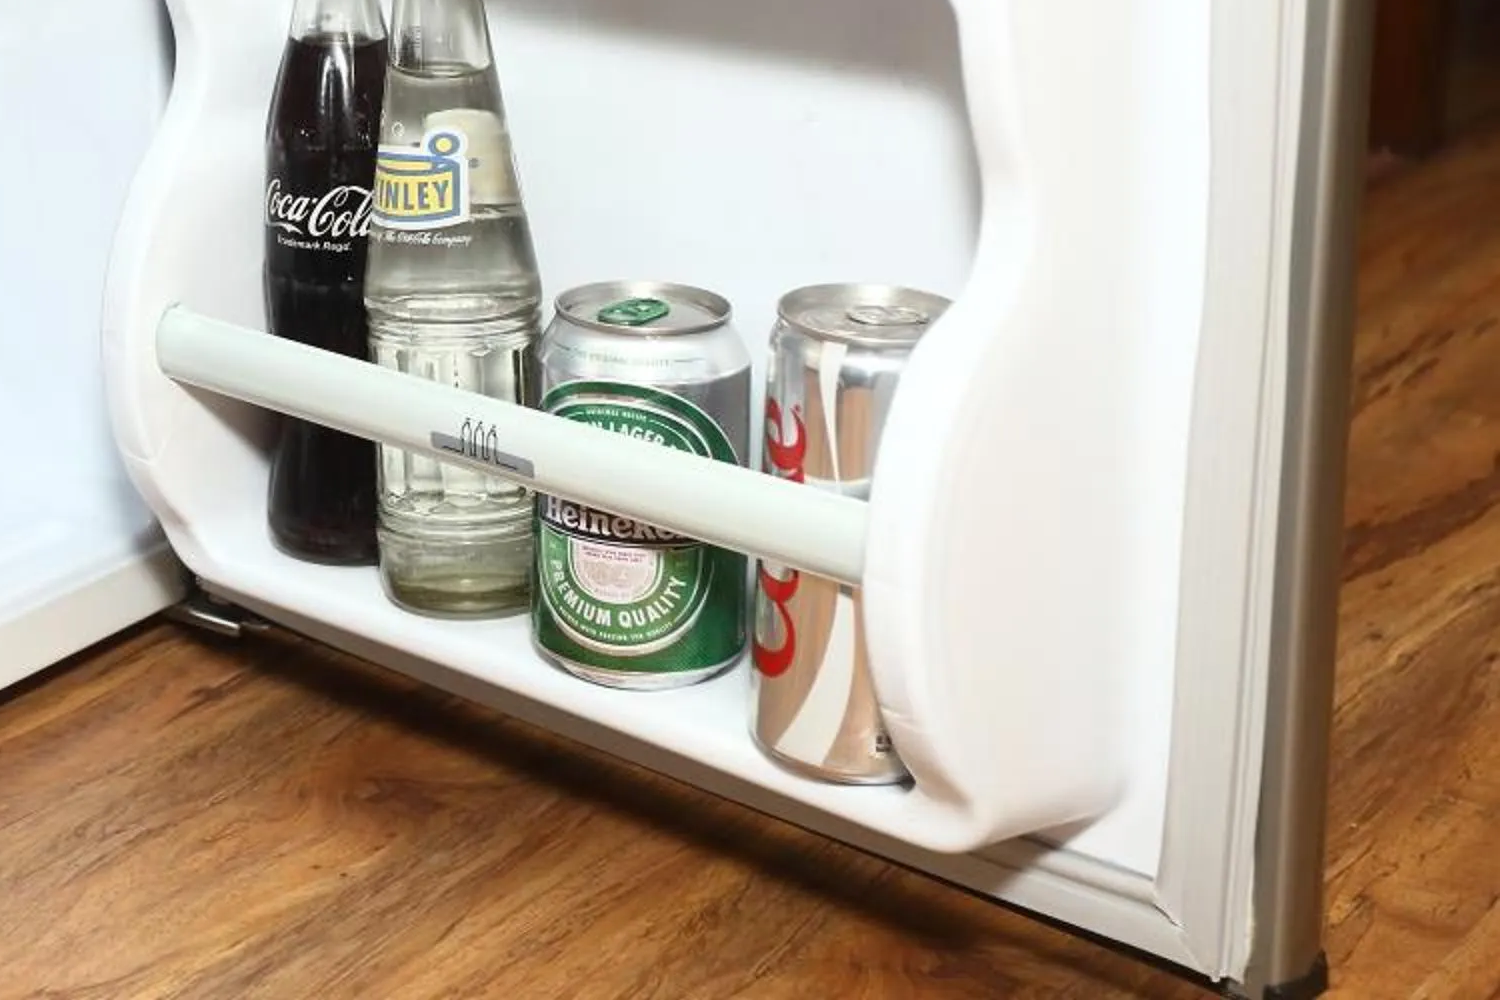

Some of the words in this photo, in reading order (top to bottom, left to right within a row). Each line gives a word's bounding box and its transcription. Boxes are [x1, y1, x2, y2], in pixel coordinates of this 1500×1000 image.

[375, 179, 450, 210] INLEY
[550, 559, 612, 627] PREMIUM
[617, 575, 687, 629] QUALITY
